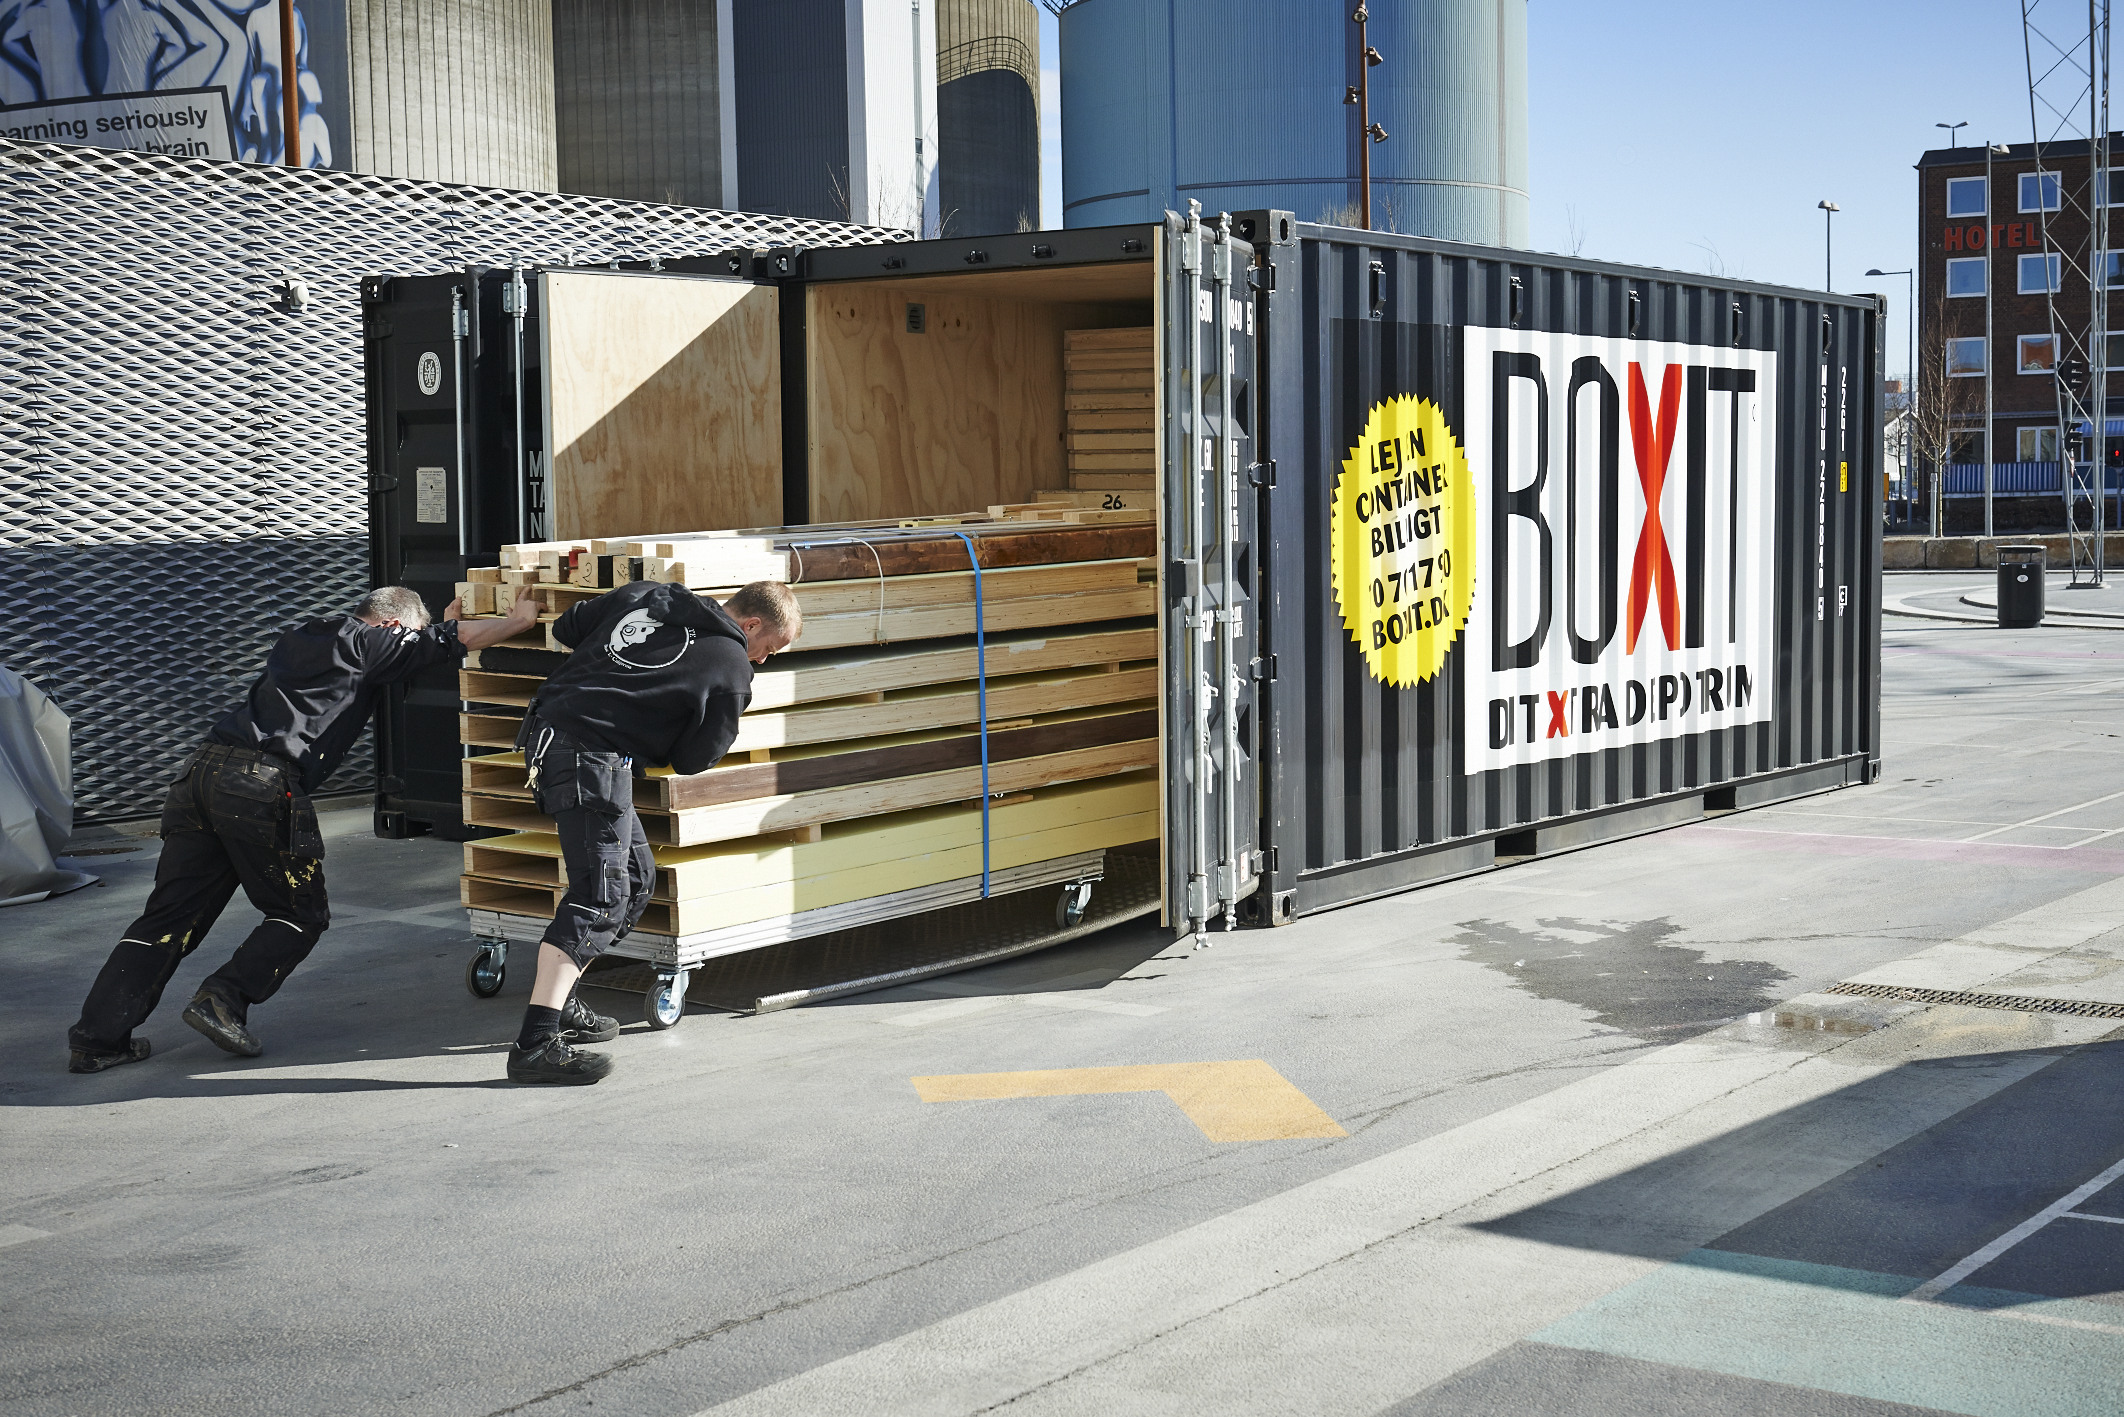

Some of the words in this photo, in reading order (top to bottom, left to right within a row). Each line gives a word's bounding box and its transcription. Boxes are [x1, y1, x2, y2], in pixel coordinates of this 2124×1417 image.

[96, 105, 208, 133] seriously
[145, 137, 210, 156] brain
[1944, 222, 2041, 251] HOTEL
[1370, 436, 1403, 478] LEJ
[1491, 349, 1757, 673] BOXIT
[1488, 693, 1540, 750] DIT
